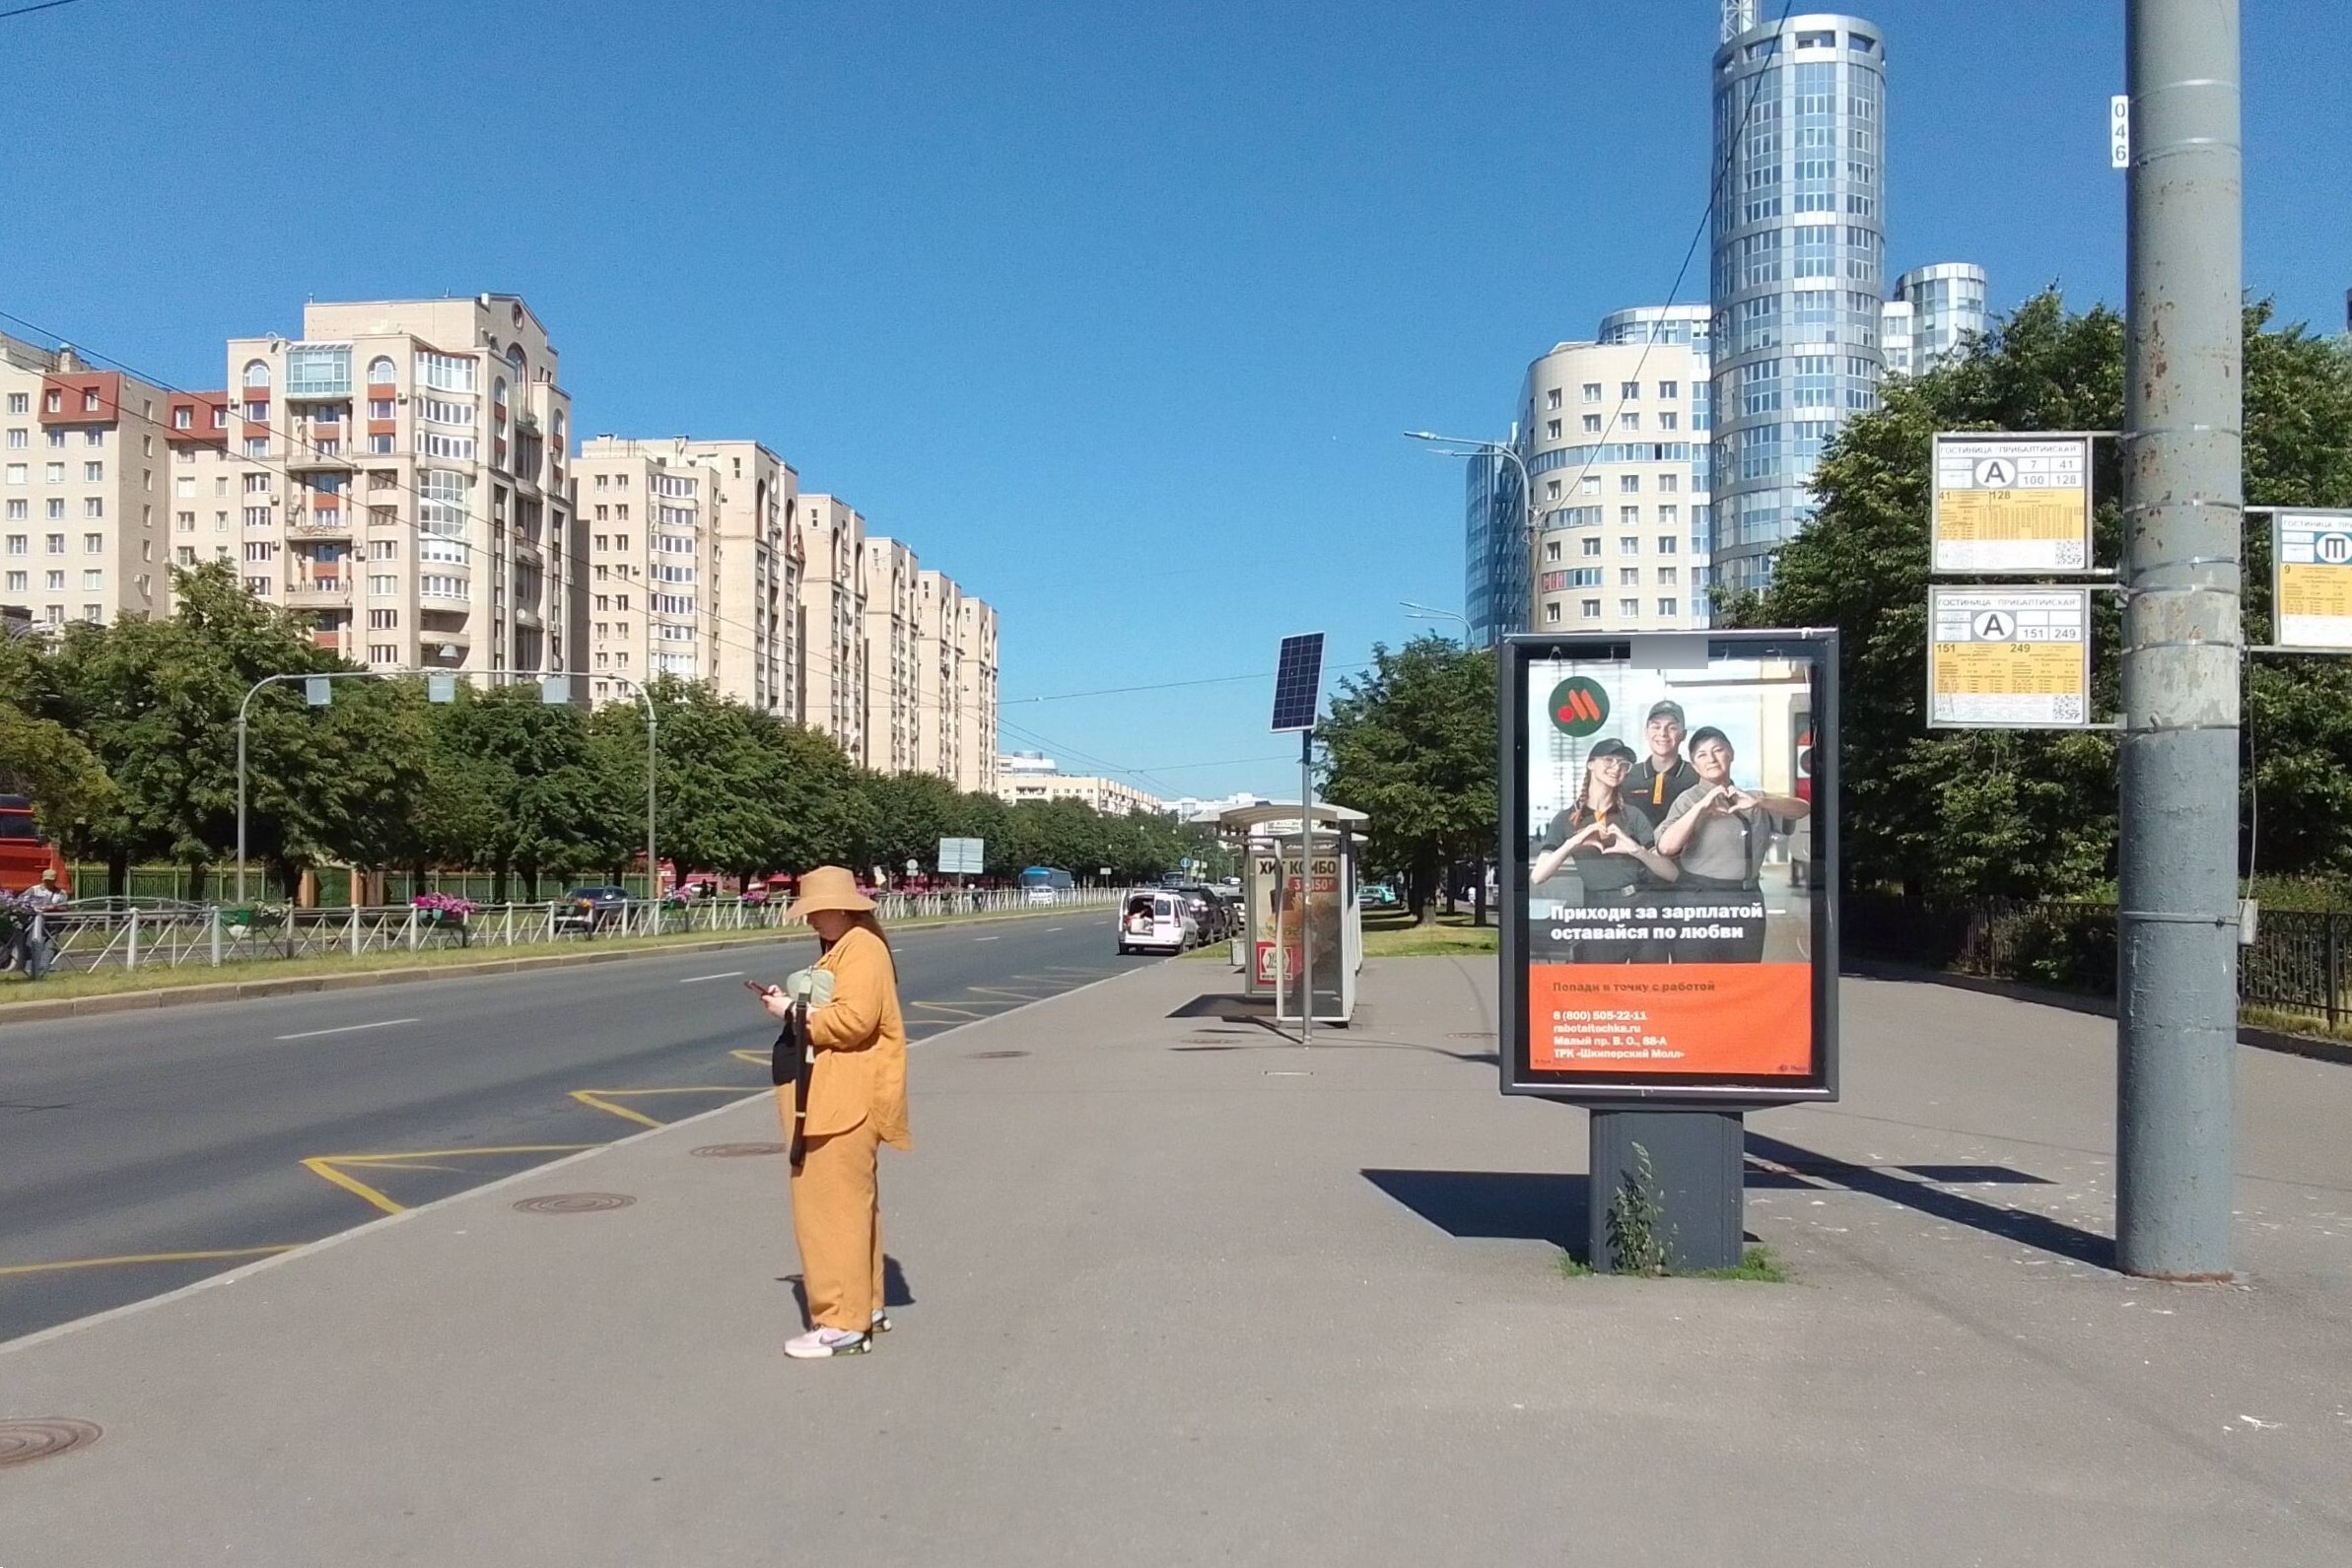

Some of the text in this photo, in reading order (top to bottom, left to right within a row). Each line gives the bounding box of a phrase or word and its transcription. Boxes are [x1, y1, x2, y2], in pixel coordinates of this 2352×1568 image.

[1940, 445, 1992, 454] ГОСТИНИЦА
[2031, 460, 2073, 469] 7 41
[2024, 476, 2077, 485] 100 128
[1939, 491, 1951, 501] 41
[1991, 491, 2011, 501] 128
[2285, 565, 2291, 574] 9
[1938, 598, 1991, 607] ГОСТИНИЦА
[2024, 629, 2076, 639] 151 249
[1936, 645, 1956, 653] 151
[2010, 644, 2031, 653] 249
[1551, 905, 1631, 922] Приходи
[1635, 907, 1658, 919] за
[1662, 903, 1763, 921] зарплатой
[1551, 923, 1744, 940] оставайся по любви
[1553, 982, 1600, 992] Попади
[1613, 984, 1649, 993] точку
[1662, 981, 1715, 993] работой
[1553, 1010, 1647, 1022] 8 (800) 505-22-11
[1554, 1035, 1592, 1046] Малый
[1594, 1038, 1611, 1048] пр.
[1554, 1049, 1574, 1058] ТРК
